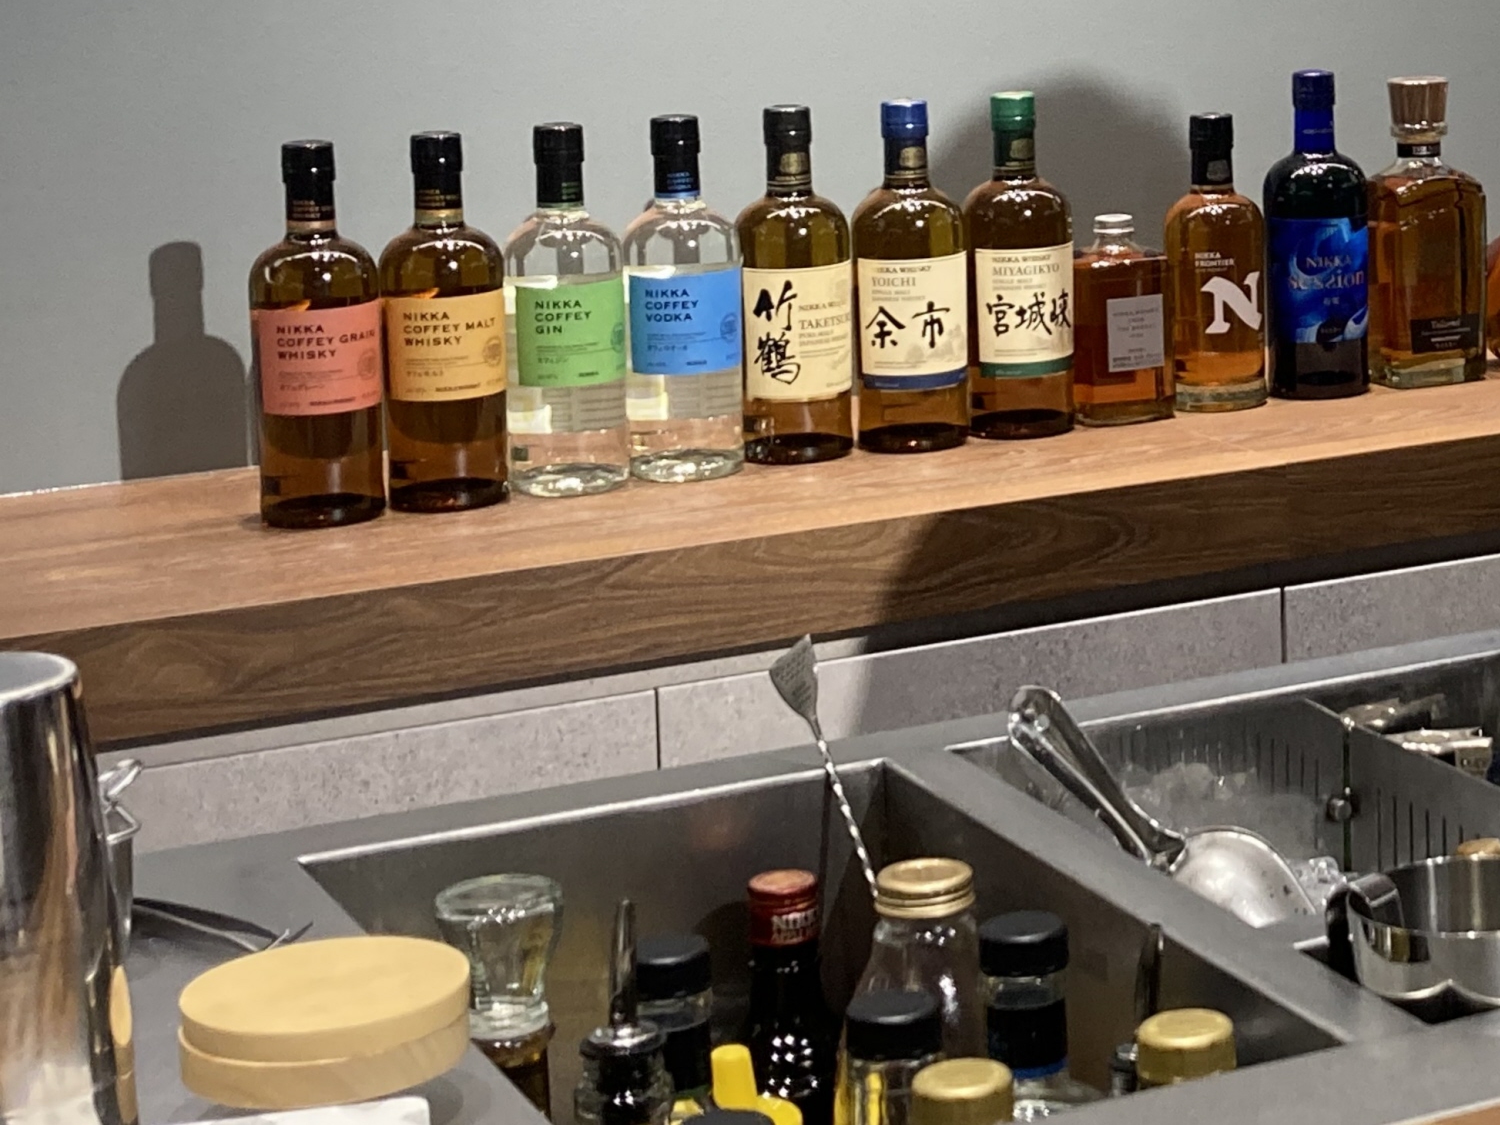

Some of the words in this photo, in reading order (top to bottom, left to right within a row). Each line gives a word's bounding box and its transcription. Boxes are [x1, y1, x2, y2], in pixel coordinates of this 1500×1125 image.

[991, 263, 1060, 276] MIYAGIKYO
[871, 277, 916, 287] YOICHI
[645, 289, 690, 298] NIKKA
[534, 300, 582, 309] NIKKA
[645, 300, 699, 310] COFFEY
[403, 311, 450, 322] NIKKA
[534, 311, 592, 322] COFFEY
[645, 313, 693, 323] VODKA
[276, 325, 324, 334] NIKKA
[403, 323, 460, 335] COFFEY
[465, 317, 496, 331] MALT
[865, 300, 950, 349] 余市
[535, 325, 563, 335] GIN
[752, 279, 801, 386] 竹鶴
[277, 337, 335, 348] COFFEY
[404, 336, 462, 347] WHISKY
[277, 350, 337, 360] WHISKY
